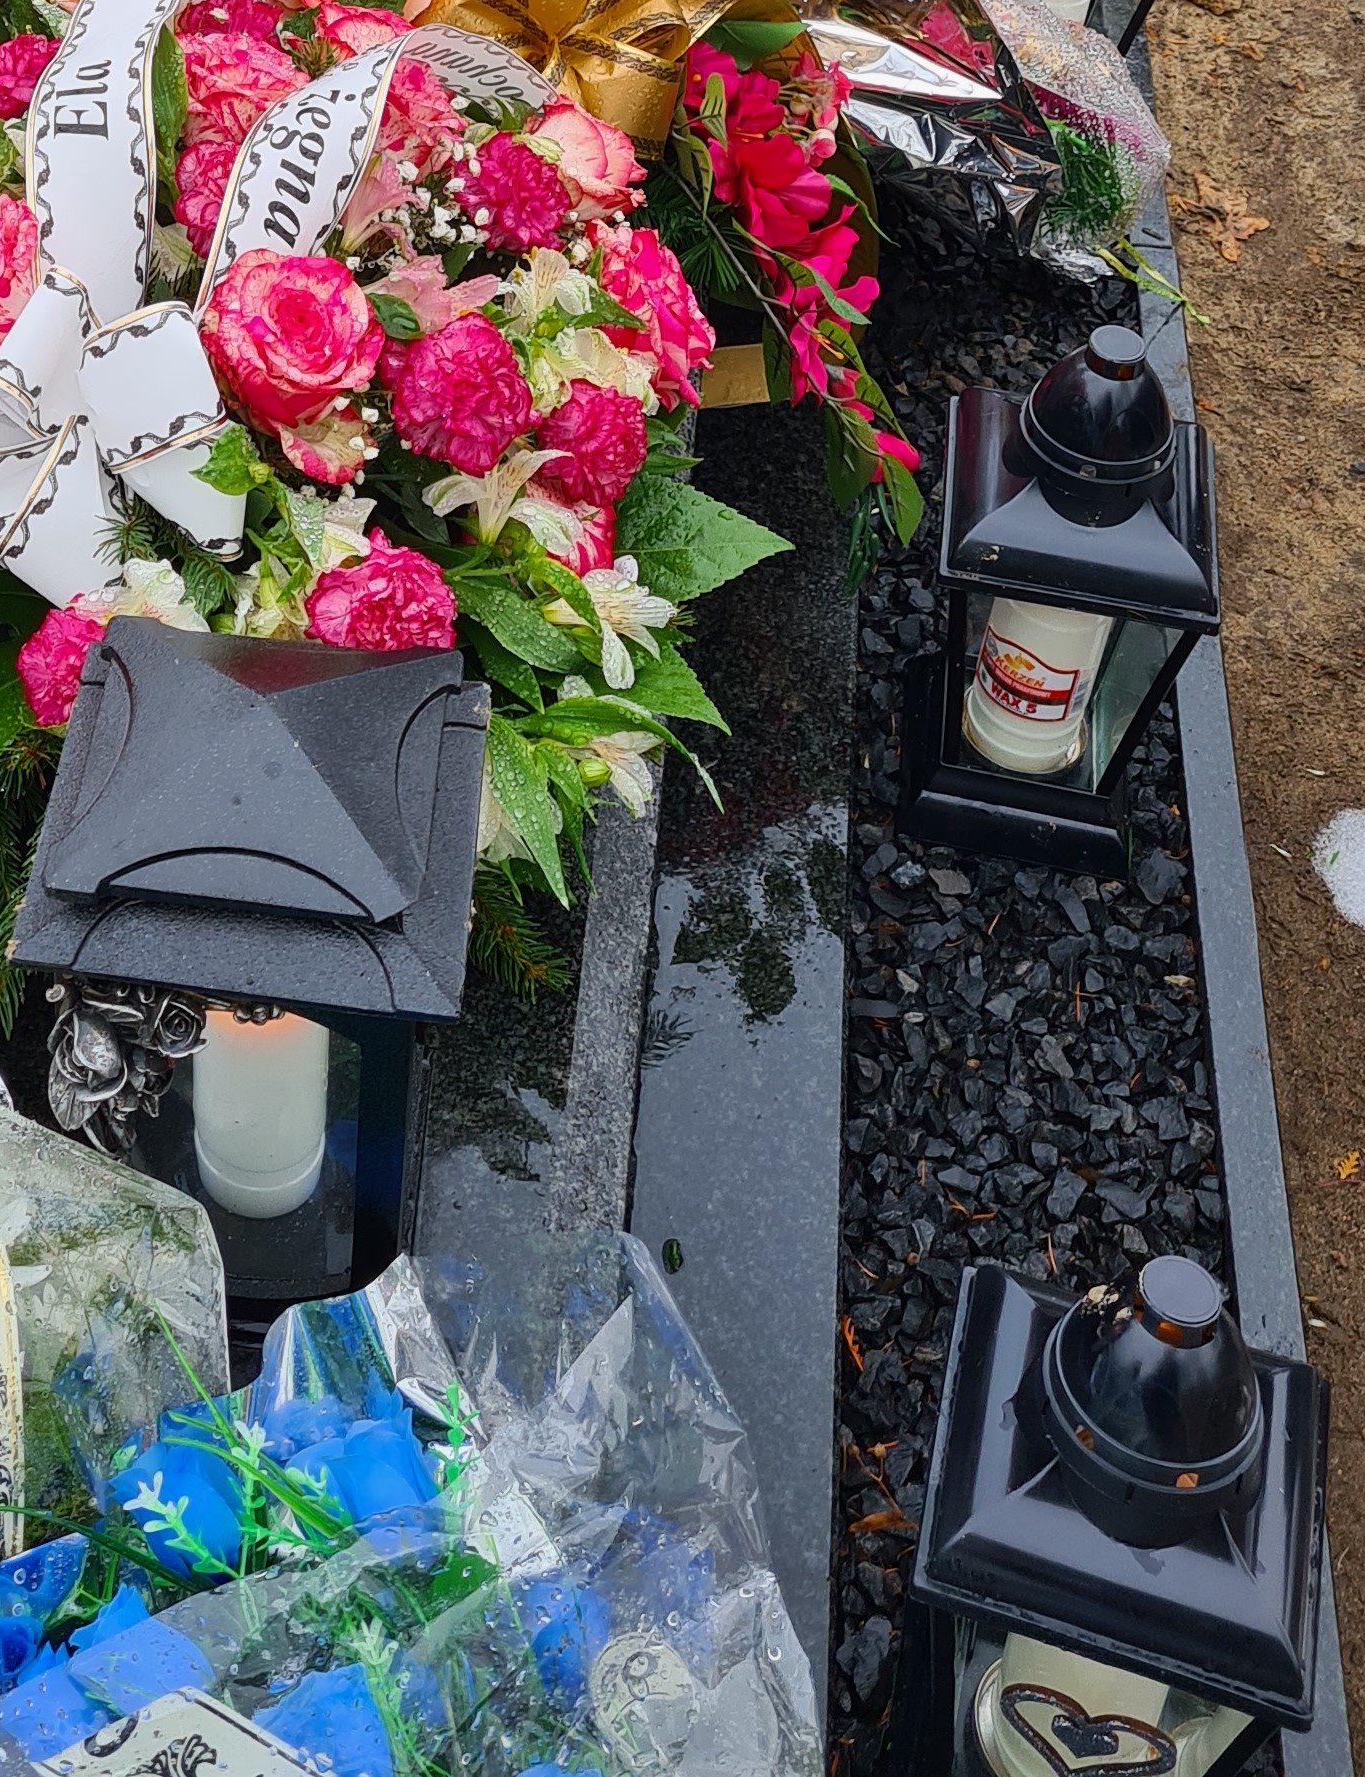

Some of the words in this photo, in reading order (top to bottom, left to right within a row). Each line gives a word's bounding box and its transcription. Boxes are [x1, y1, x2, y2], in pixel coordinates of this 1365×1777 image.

[53, 59, 113, 141] Ela
[995, 655, 1046, 689] KERZEN
[990, 680, 1022, 708] WAX
